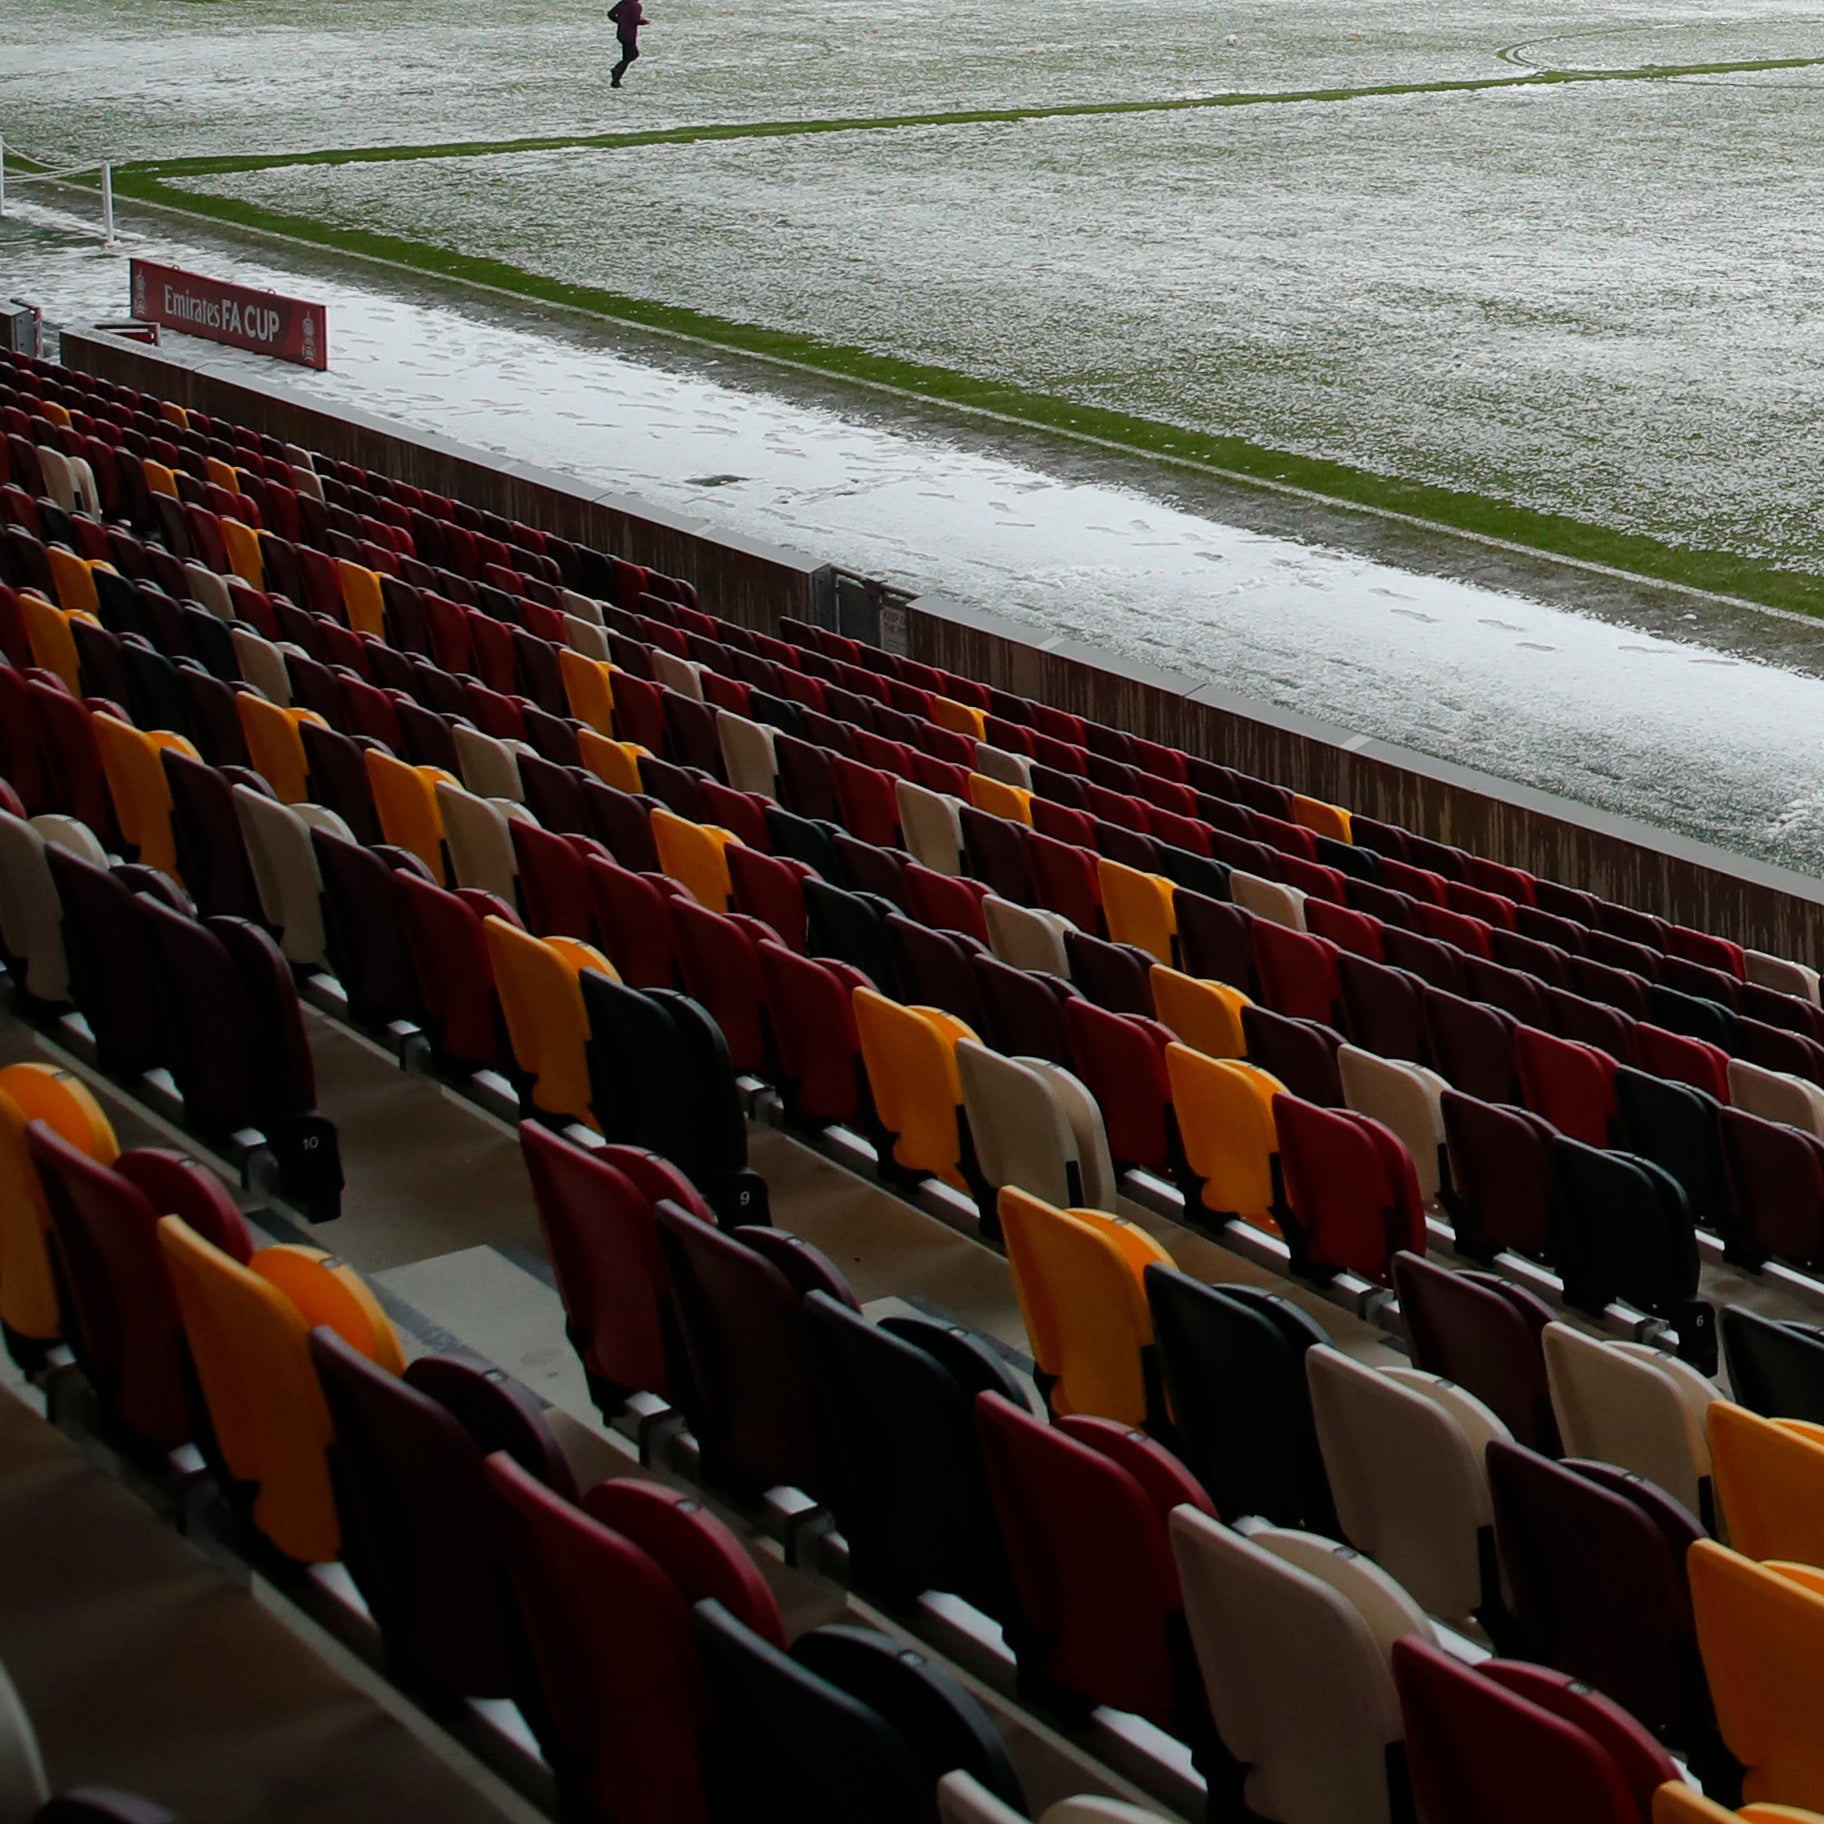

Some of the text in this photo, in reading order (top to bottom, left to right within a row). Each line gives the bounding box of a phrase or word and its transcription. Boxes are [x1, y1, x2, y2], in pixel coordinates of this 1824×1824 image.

[164, 284, 281, 343] Emirates FA CUP
[303, 1136, 319, 1151] 10
[740, 1191, 750, 1206] 9
[1697, 1315, 1703, 1327] 6
